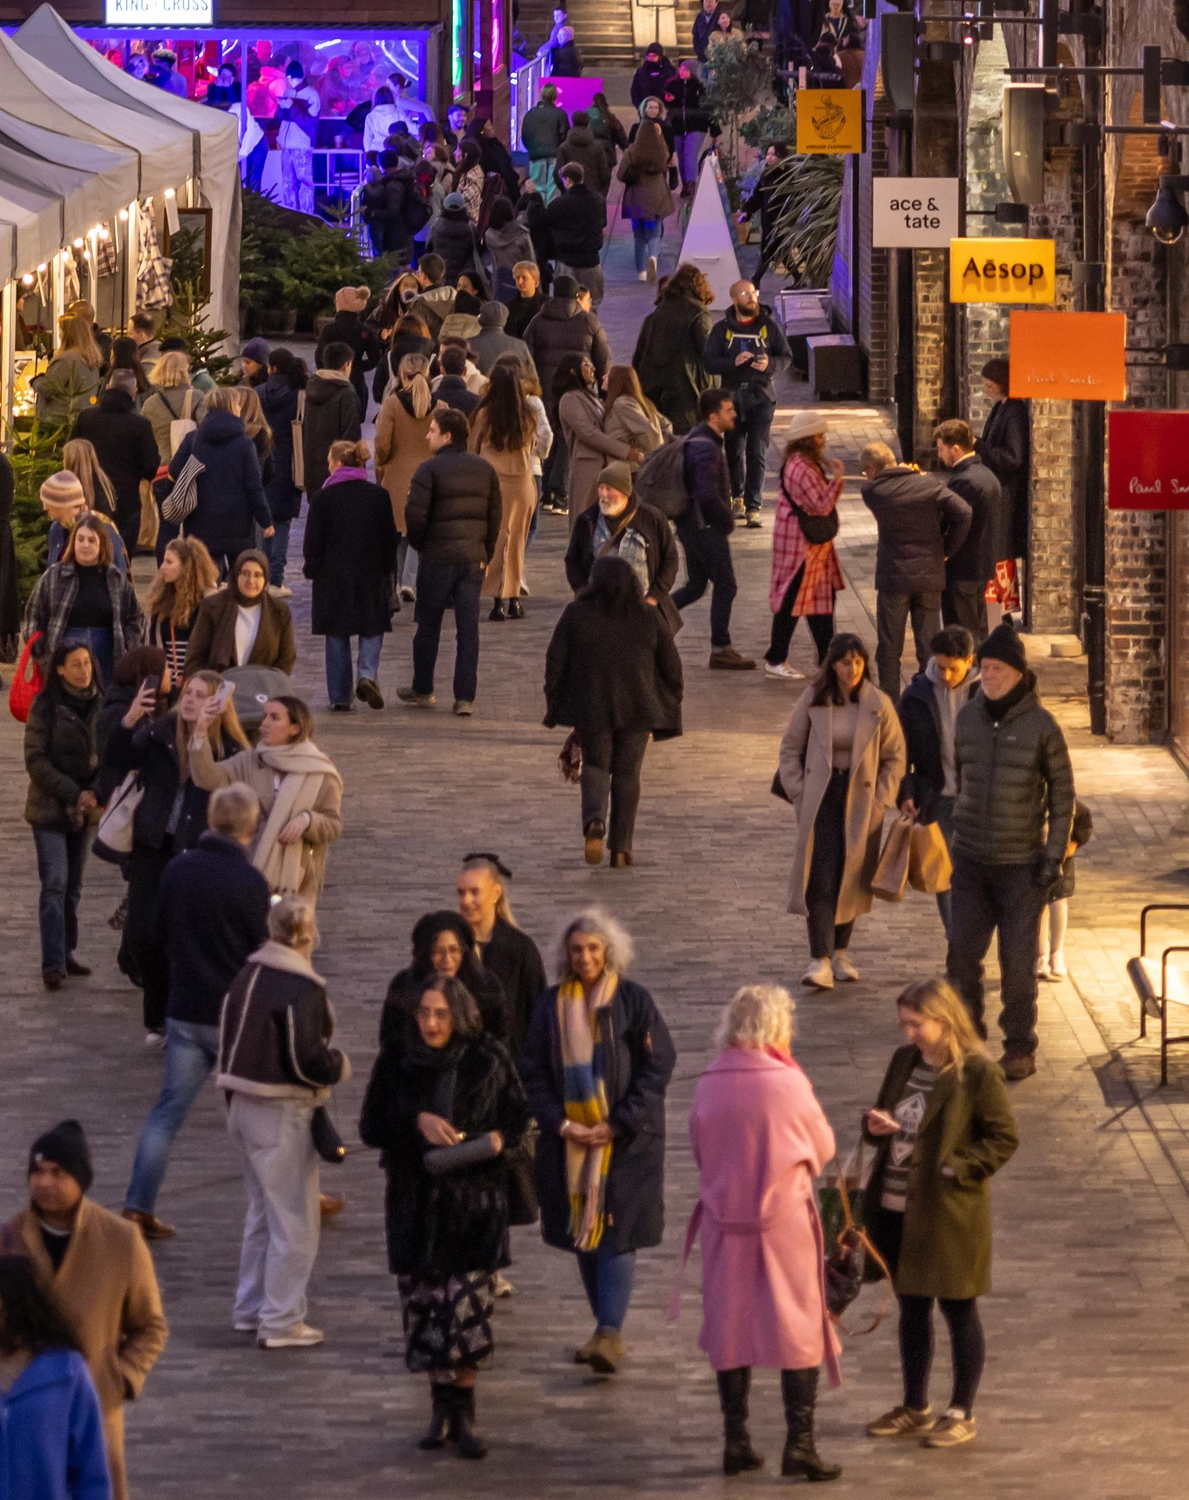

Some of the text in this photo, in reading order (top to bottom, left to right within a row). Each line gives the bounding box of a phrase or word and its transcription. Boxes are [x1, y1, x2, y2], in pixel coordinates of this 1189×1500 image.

[889, 196, 940, 212] ace &
[904, 213, 941, 230] tate
[1129, 476, 1162, 494] Paul
